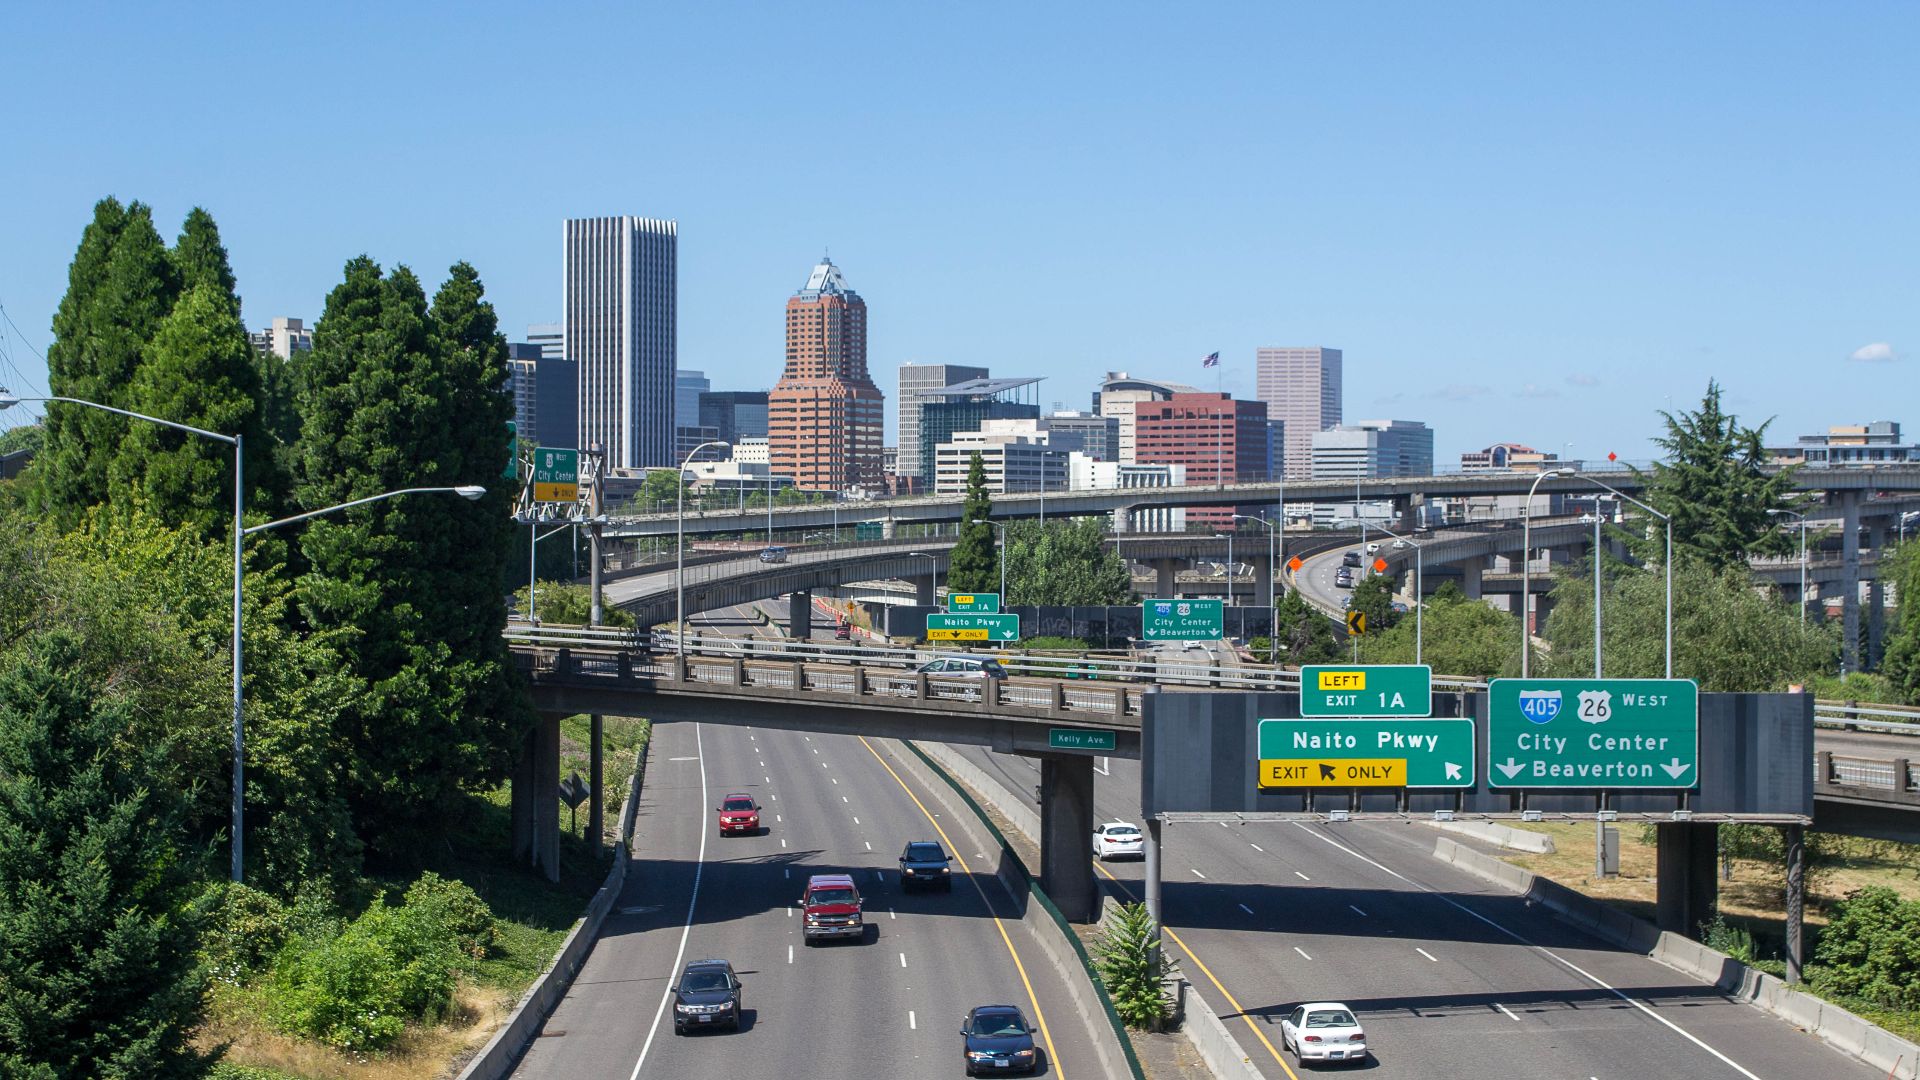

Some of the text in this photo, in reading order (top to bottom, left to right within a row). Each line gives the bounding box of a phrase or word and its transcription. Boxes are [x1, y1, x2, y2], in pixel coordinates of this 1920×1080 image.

[538, 470, 575, 482] City Center
[978, 603, 989, 611] 1A
[1178, 606, 1190, 614] 26
[944, 618, 1001, 627] Naito Pkwy
[1154, 618, 1212, 627] City Center
[1160, 628, 1206, 636] Beaverton
[1324, 675, 1359, 687] LEFT
[1326, 692, 1406, 708] EXIT 1A
[1523, 693, 1668, 718] 405 26 WEST
[1058, 734, 1105, 744] Kelly Ave.
[1293, 731, 1439, 753] Naito Pkwy
[1517, 733, 1669, 755] City Center
[1272, 766, 1393, 779] EXIT ONLY
[1532, 760, 1654, 778] Beaverton
